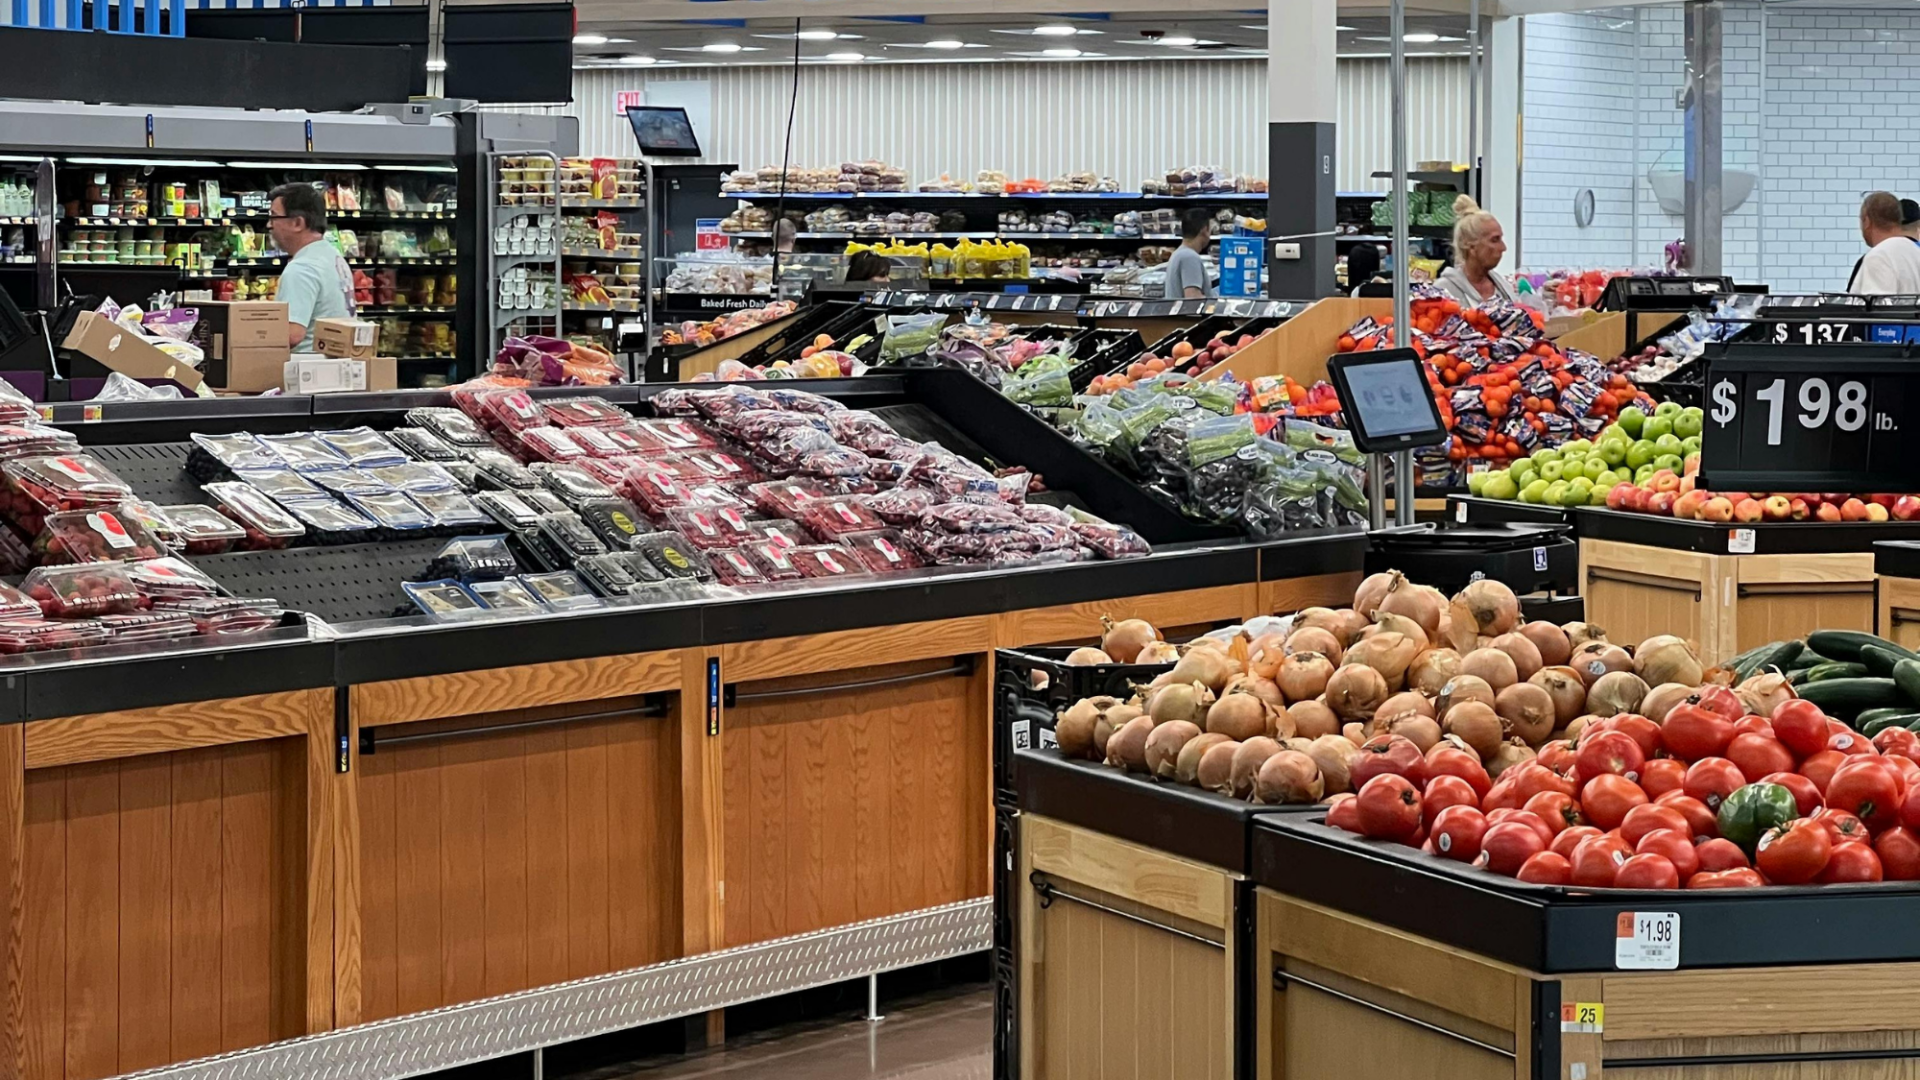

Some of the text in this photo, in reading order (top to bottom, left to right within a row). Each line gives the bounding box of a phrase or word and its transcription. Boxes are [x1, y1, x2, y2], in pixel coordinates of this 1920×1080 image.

[617, 92, 640, 112] EXIT
[701, 299, 725, 308] Baked
[726, 299, 748, 308] Fresh
[1875, 412, 1899, 431] lb.
[1640, 919, 1672, 942] $1.98
[1580, 1007, 1596, 1023] 25
